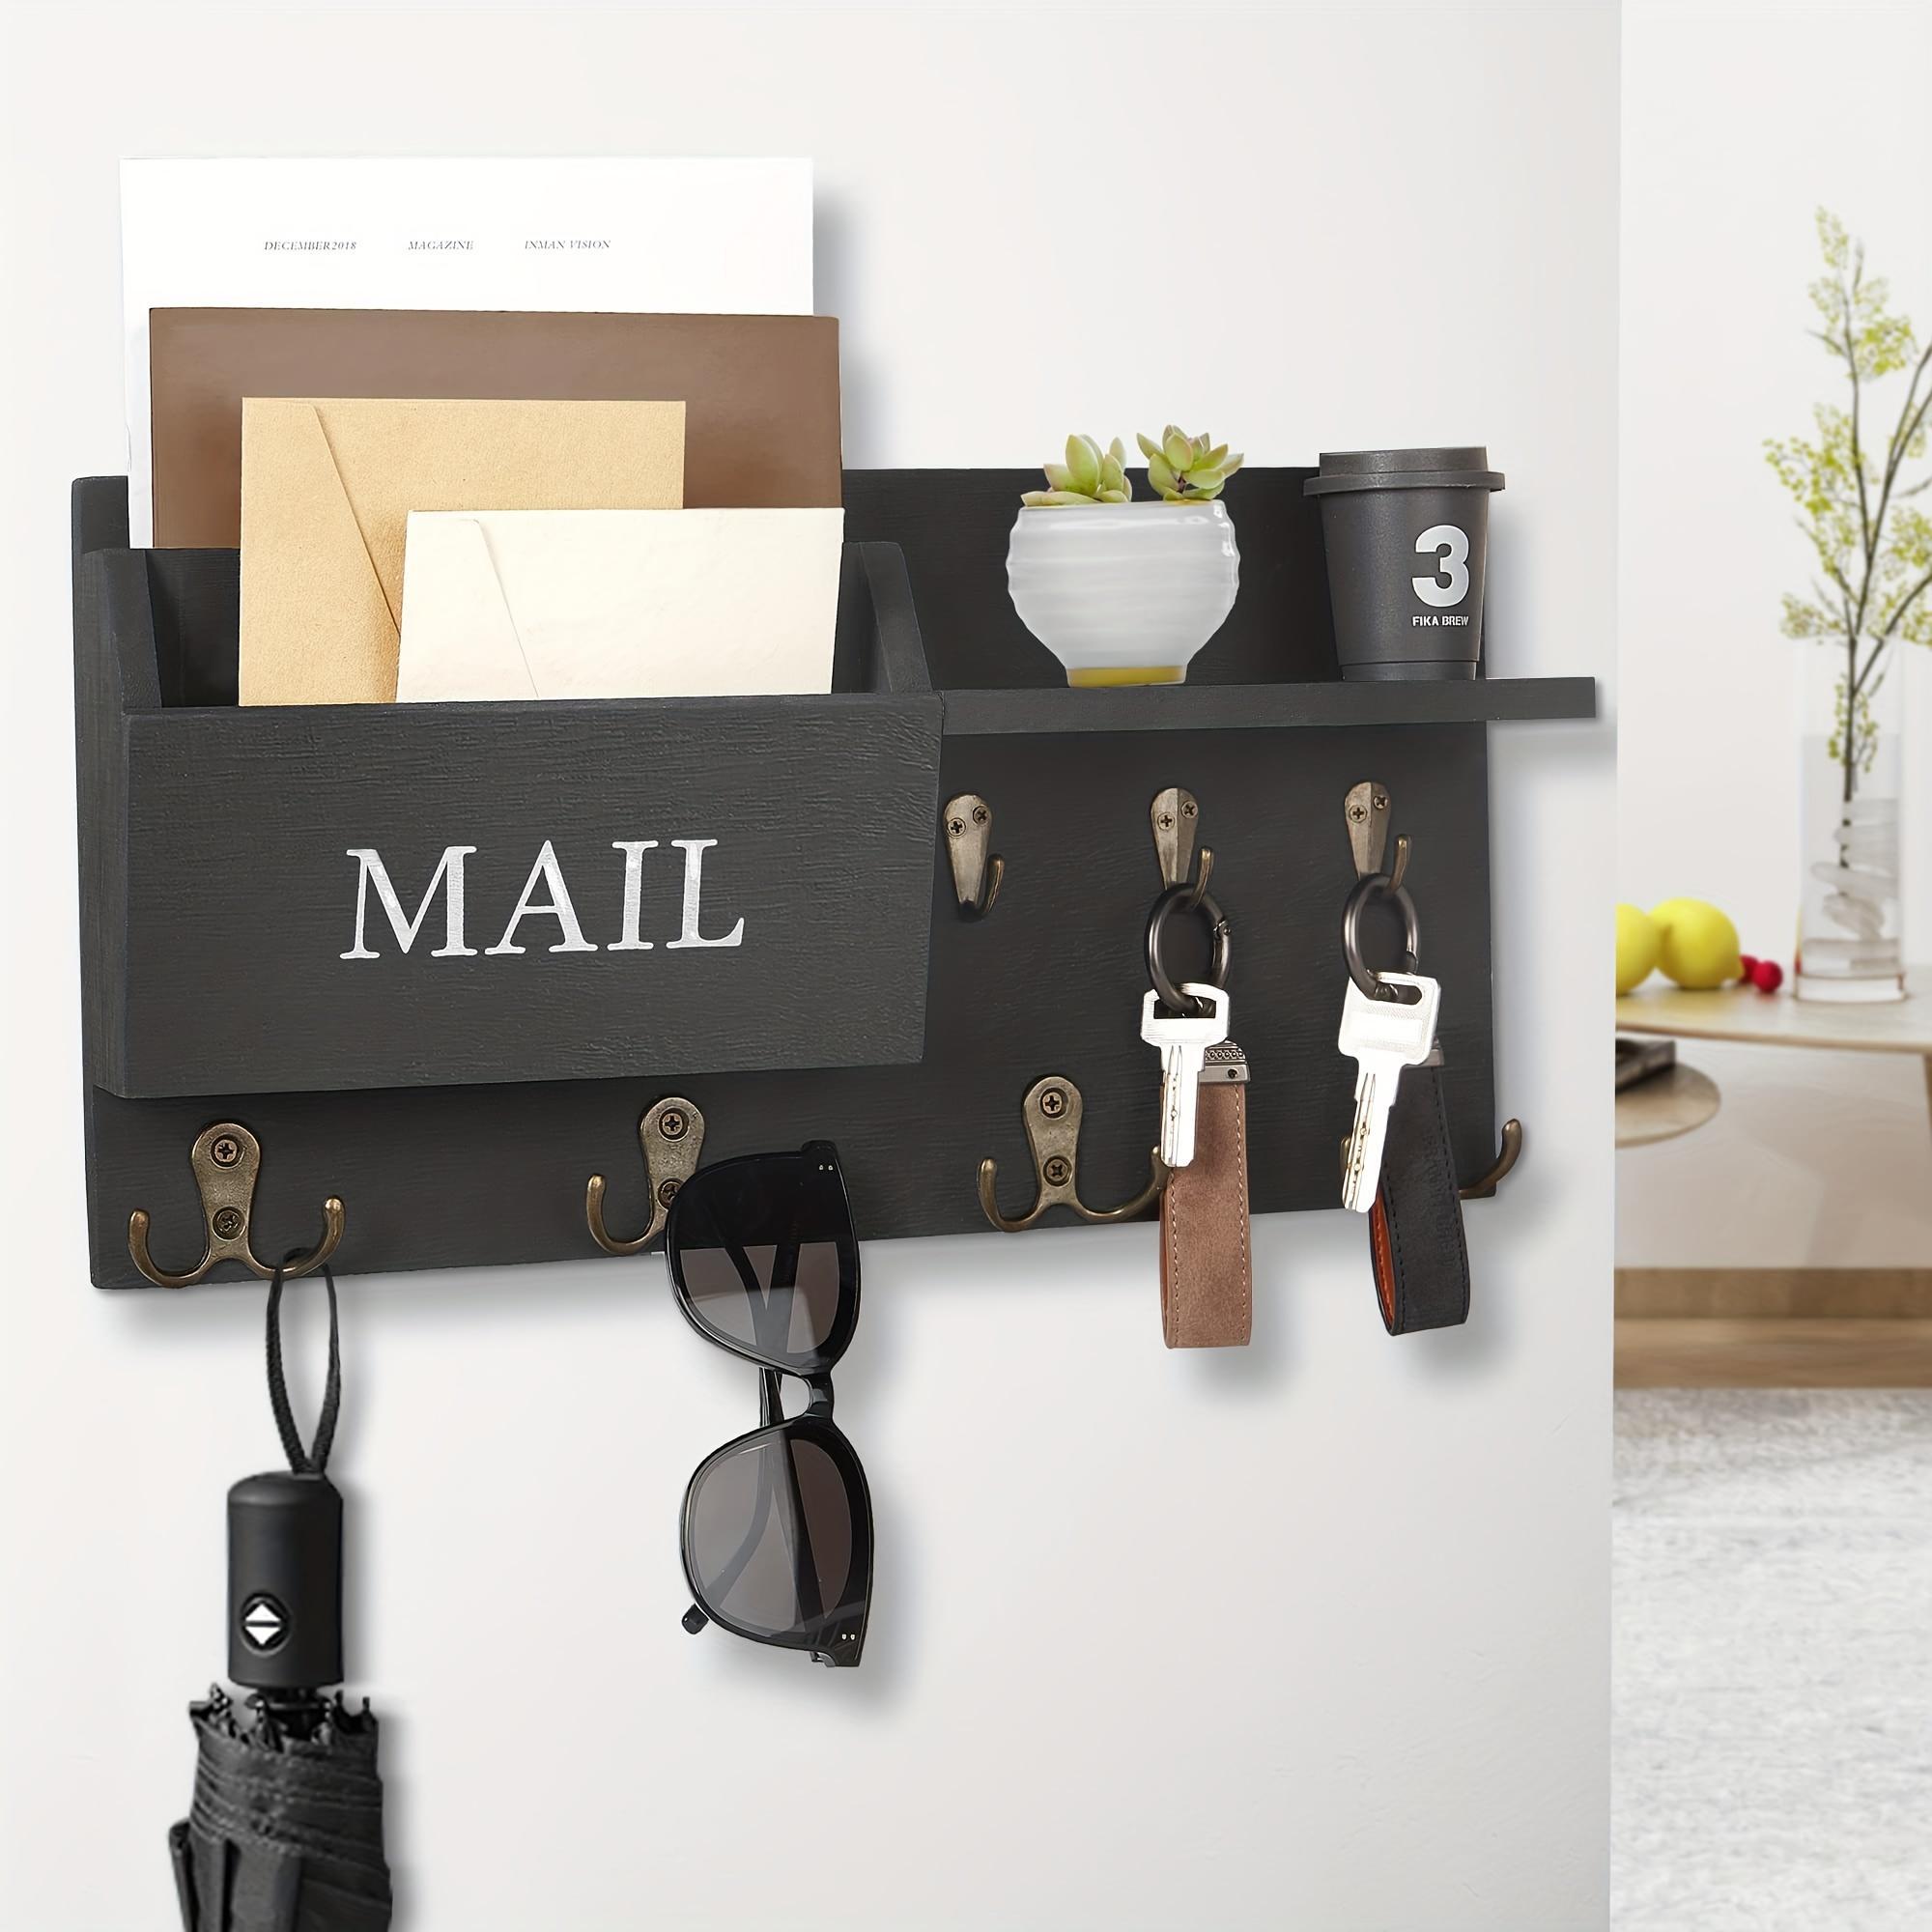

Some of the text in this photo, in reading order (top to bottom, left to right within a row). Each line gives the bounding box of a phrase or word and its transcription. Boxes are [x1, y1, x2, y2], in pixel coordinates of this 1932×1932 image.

[264, 241, 357, 251] DECEMBER2018
[408, 240, 474, 251] MAGAZINE
[525, 240, 611, 251] INMAN VISION
[1411, 525, 1469, 608] 3
[1412, 615, 1469, 628] FIKA BREW
[339, 838, 745, 960] MAIL
